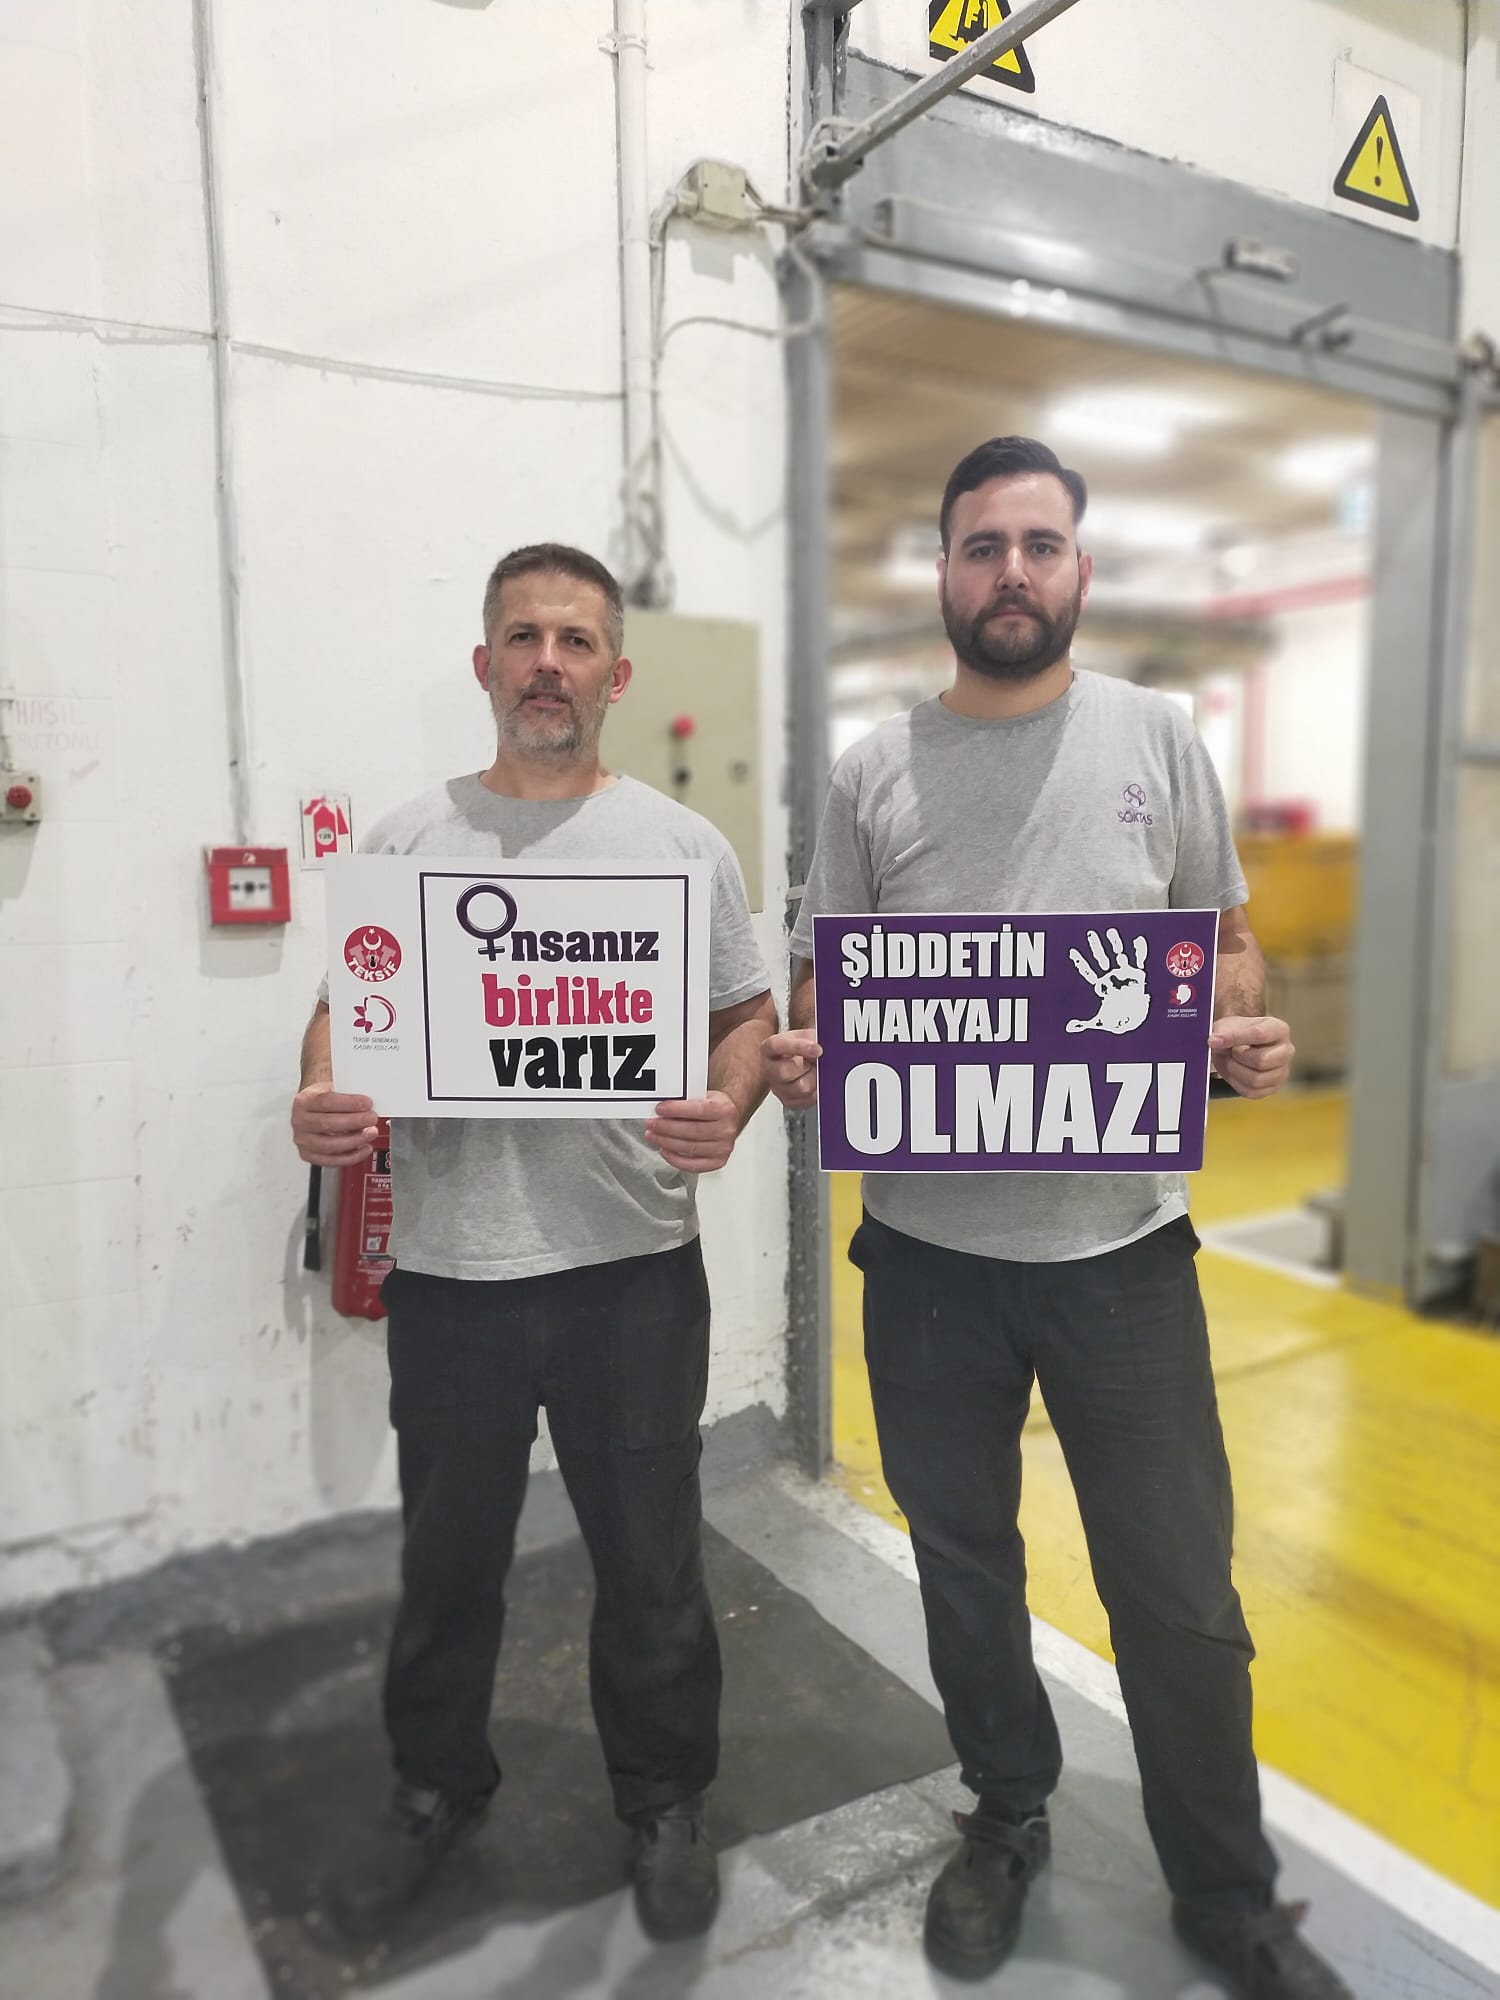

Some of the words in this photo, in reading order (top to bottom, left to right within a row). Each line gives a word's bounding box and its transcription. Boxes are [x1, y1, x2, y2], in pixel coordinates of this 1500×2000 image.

[840, 924, 1046, 987] ŞİDDETİN
[482, 973, 653, 1026] birlikte
[843, 998, 1029, 1043] MAKYAJI
[489, 1034, 657, 1091] varız
[843, 1061, 1186, 1154] OLMAZ!
